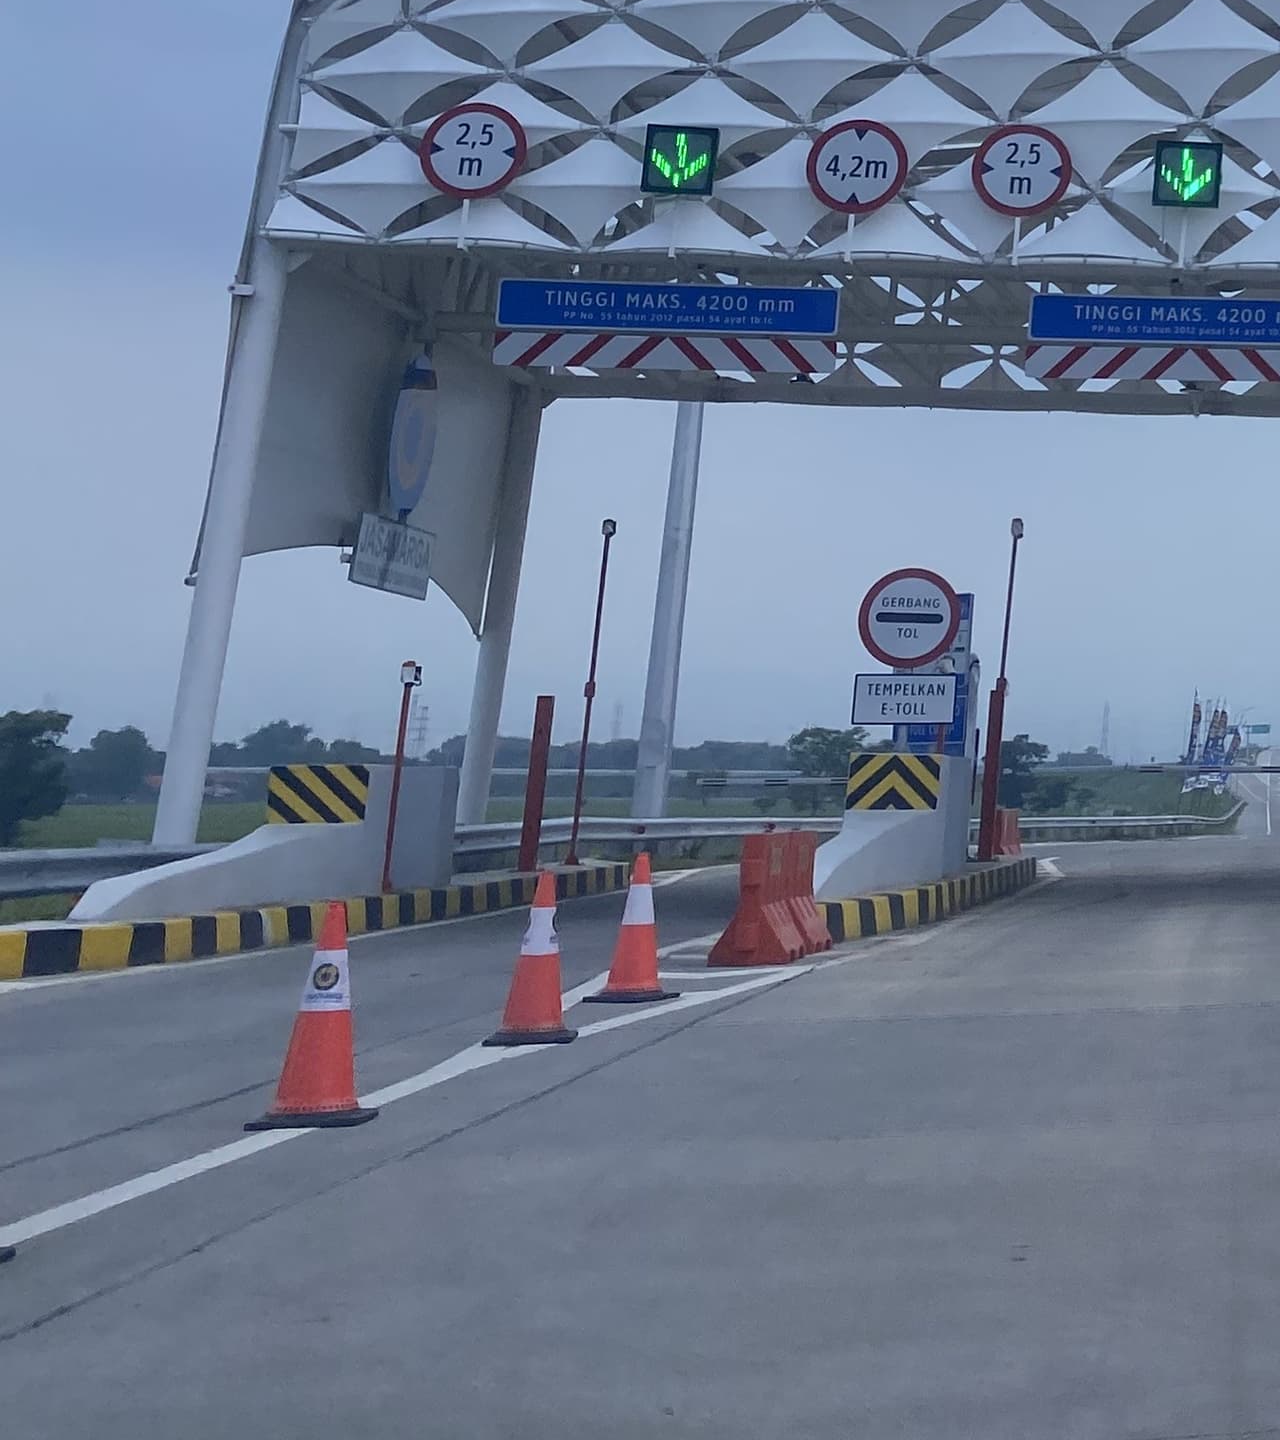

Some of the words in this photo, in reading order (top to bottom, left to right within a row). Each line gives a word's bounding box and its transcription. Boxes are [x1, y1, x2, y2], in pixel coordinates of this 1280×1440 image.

[454, 122, 494, 148] 2,5
[1004, 142, 1042, 166] 2,5
[457, 155, 483, 177] m
[824, 154, 889, 184] 4,2m
[1008, 174, 1033, 196] m
[545, 290, 616, 308] TINGGI
[626, 293, 687, 310] MAKS.
[696, 295, 749, 312] 4200
[758, 298, 796, 313] mm
[1073, 304, 1142, 321] TINGGI
[1150, 307, 1209, 323] MAKS.
[1217, 308, 1267, 323] 4200
[881, 597, 941, 609] GERBANG
[897, 627, 920, 639] TOL
[867, 683, 947, 697] TEMPELKAN
[880, 702, 928, 716] E-TOLL
